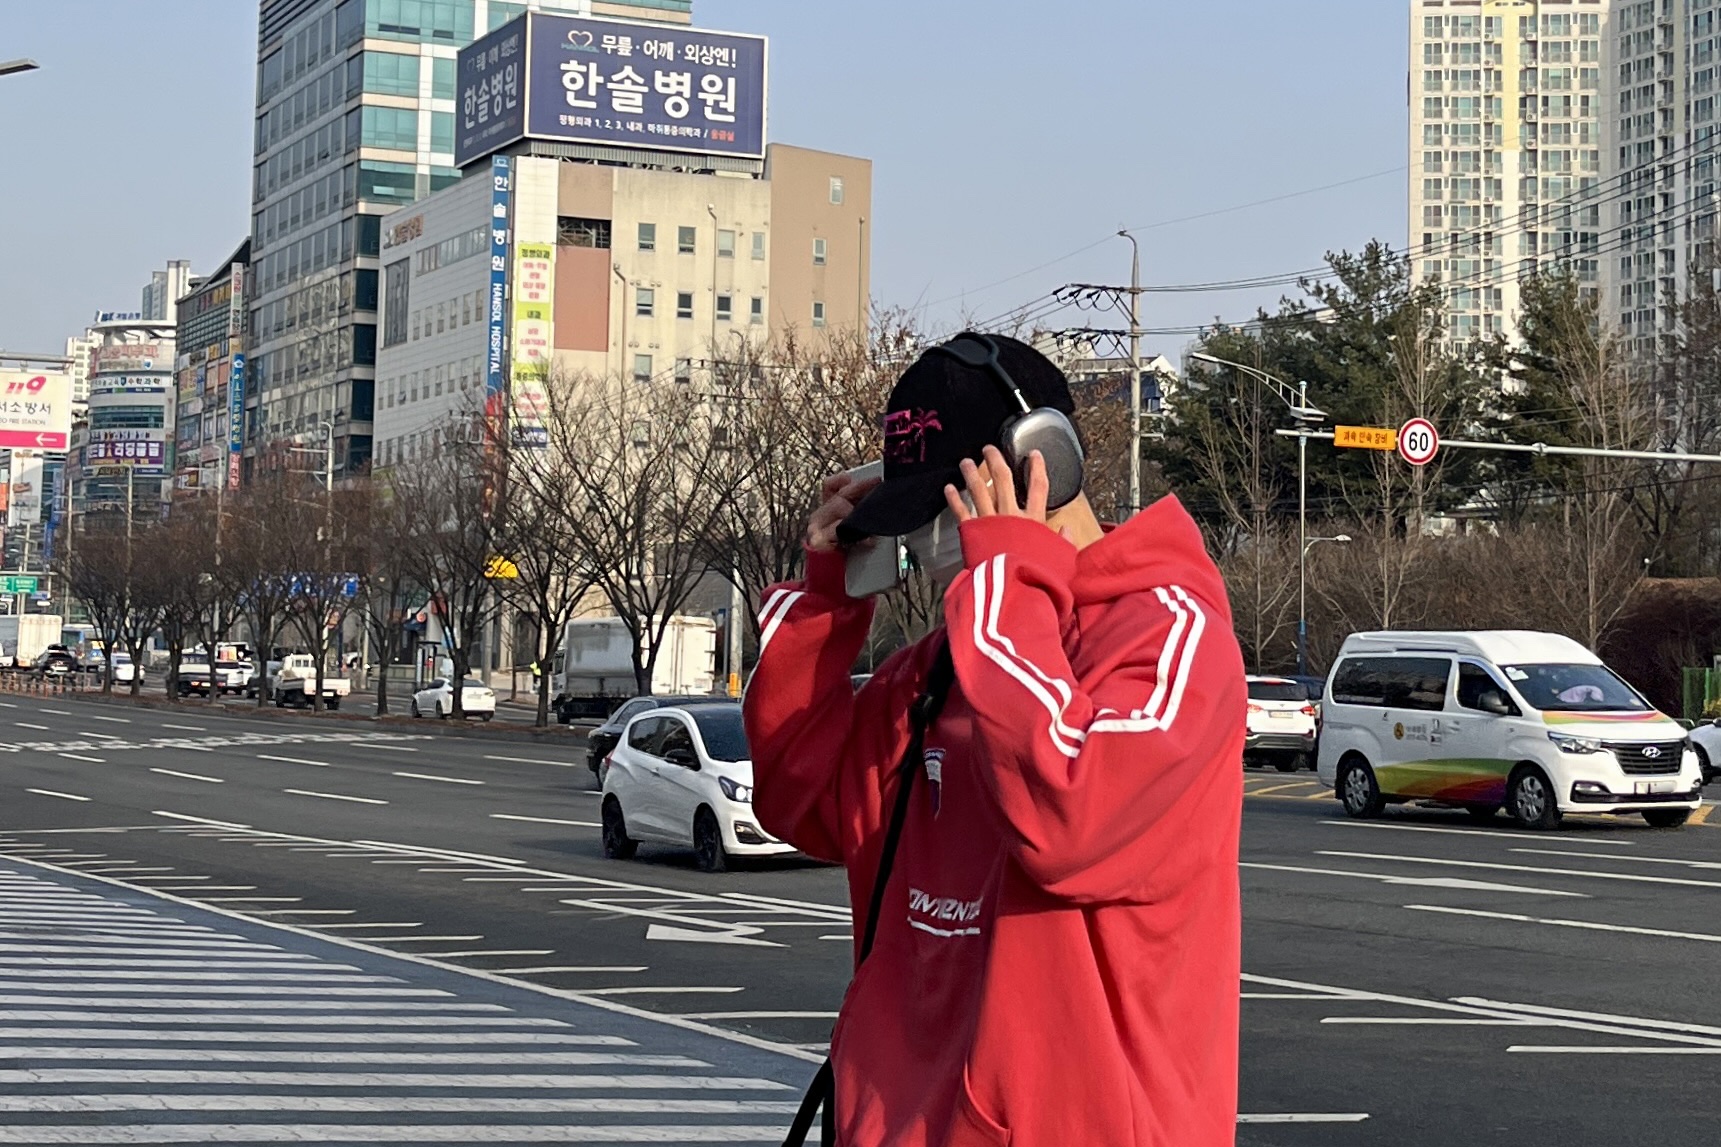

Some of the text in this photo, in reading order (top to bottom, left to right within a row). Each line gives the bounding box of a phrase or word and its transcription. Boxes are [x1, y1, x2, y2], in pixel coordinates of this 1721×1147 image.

[601, 34, 736, 68] 무릎 어깨 외상엔!
[464, 62, 518, 130] 한솔병원
[559, 59, 736, 122] 한솔병원
[491, 175, 509, 272] 한솔병원
[490, 283, 503, 375] HANSOL HOSPITAL
[5, 376, 47, 395] 119
[1409, 432, 1429, 451] 60
